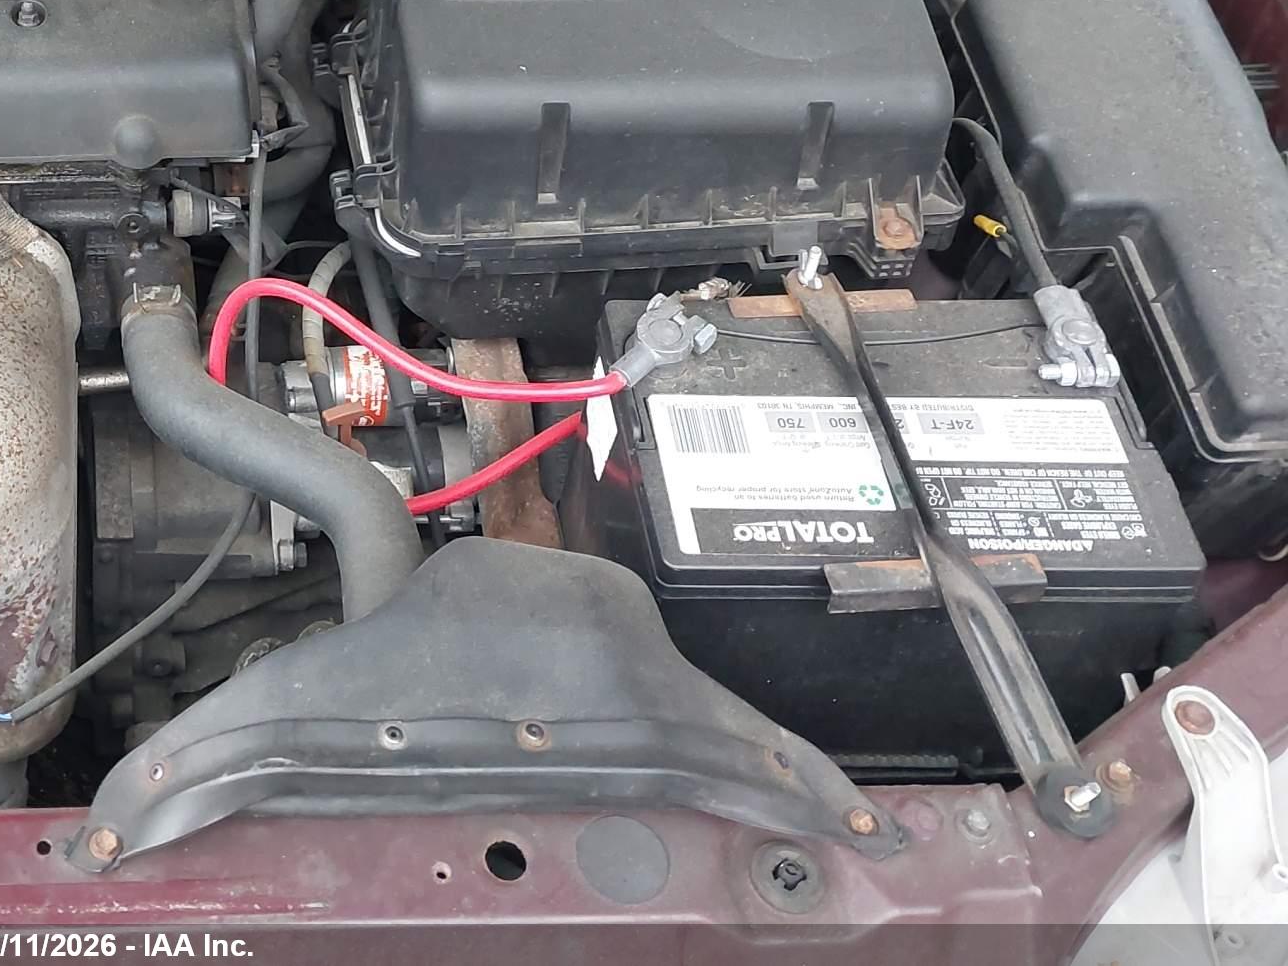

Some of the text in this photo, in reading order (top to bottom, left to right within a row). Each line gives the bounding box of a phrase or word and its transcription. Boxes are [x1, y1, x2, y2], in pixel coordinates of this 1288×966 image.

[776, 417, 806, 429] 750
[828, 417, 857, 428] 600
[930, 418, 974, 430] 24F-T
[746, 494, 757, 502] to
[823, 495, 854, 503] Return
[732, 520, 874, 544] TOTALPRO
[967, 538, 1084, 552] DANGER/POISON
